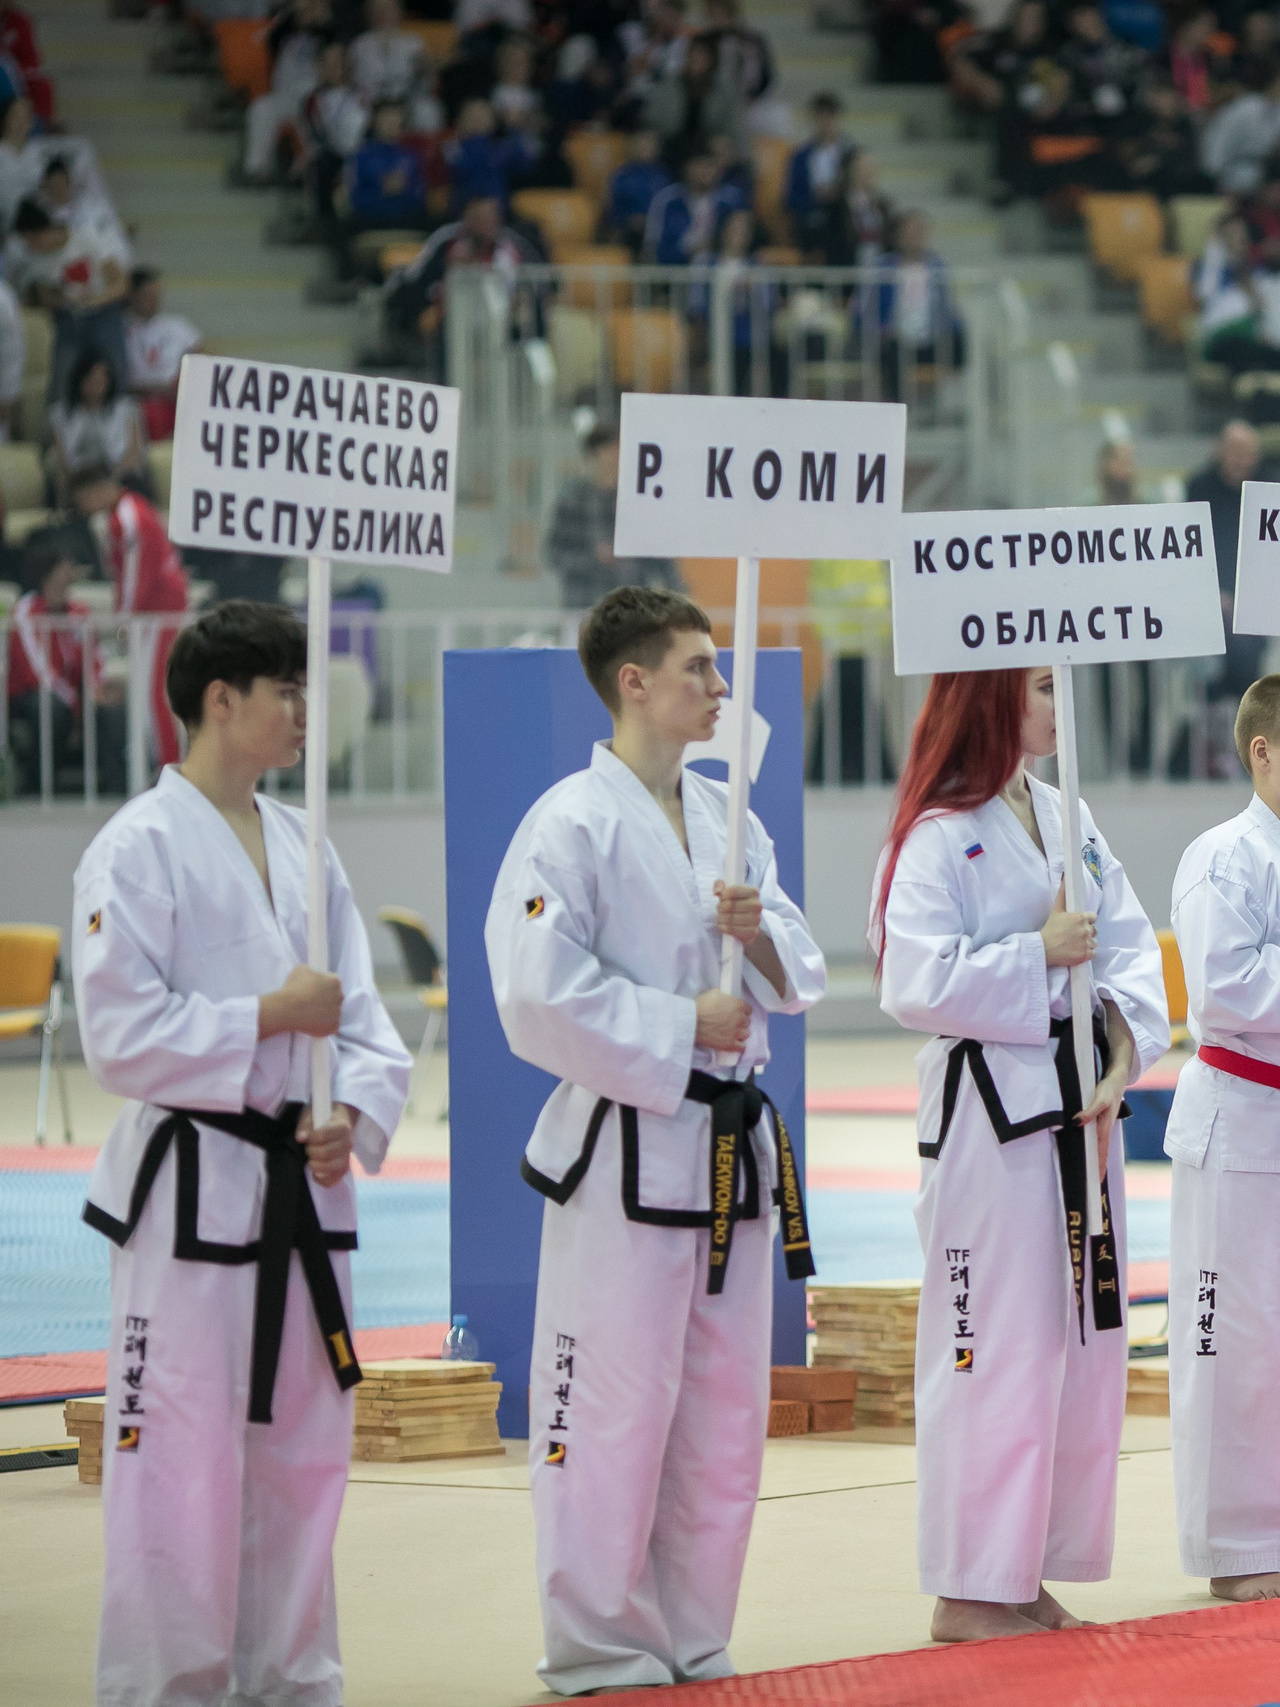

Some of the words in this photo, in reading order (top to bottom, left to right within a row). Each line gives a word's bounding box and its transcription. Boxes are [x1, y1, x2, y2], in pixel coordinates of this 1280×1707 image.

[209, 363, 439, 434] КАРАЧАЕВО
[201, 420, 449, 492] ЧЕРКЕССКАЯ
[636, 441, 663, 499] Р.
[706, 446, 886, 504] КОМИ
[191, 488, 446, 556] РЕСПУБЛИКА
[913, 524, 1203, 575] КОСТРОМСКАЯ
[960, 605, 1164, 649] ОБЛАСТЬ
[713, 1133, 736, 1245] TAEKWON-DO
[946, 1248, 970, 1263] ITF
[1199, 1269, 1218, 1285] ITF
[126, 1315, 149, 1332] ITF
[950, 1265, 974, 1338] 태권도
[1196, 1287, 1217, 1356] 태권도
[556, 1333, 576, 1351] ITF
[548, 1353, 574, 1431] 태권도
